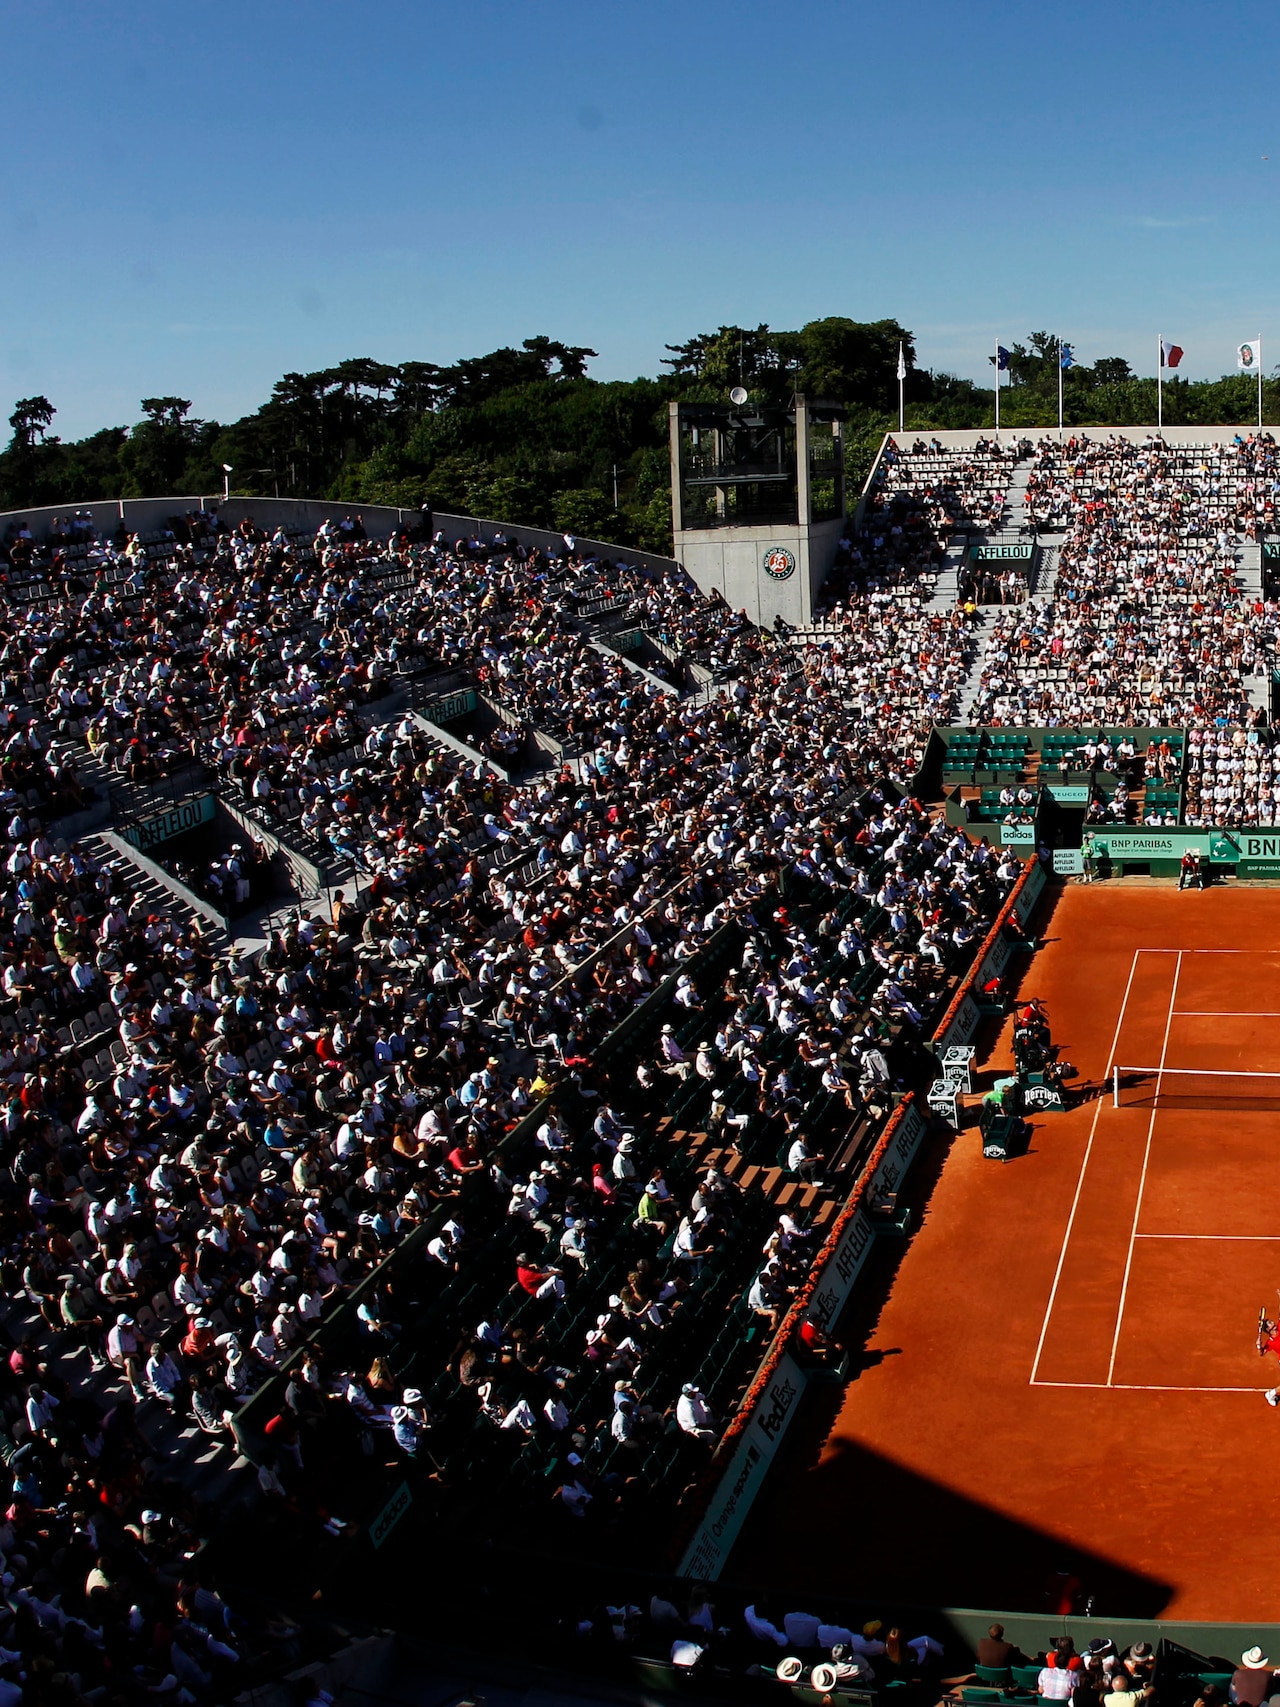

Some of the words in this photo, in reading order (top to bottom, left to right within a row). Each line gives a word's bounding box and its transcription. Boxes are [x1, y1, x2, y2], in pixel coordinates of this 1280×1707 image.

[977, 546, 1028, 559] AFFLELOU
[141, 801, 202, 843] AFFLELOU
[1003, 831, 1033, 839] adidas
[1111, 840, 1131, 848] BNP
[1133, 839, 1173, 849] PARIBAS
[896, 1111, 923, 1162] AFFLELOU
[875, 1162, 900, 1198] FedEx
[836, 1213, 873, 1285] AFFLELOU
[757, 1378, 797, 1442] FedEx
[374, 1491, 408, 1540] adidas
[711, 1495, 737, 1538] Orange
[732, 1457, 753, 1498] sport
